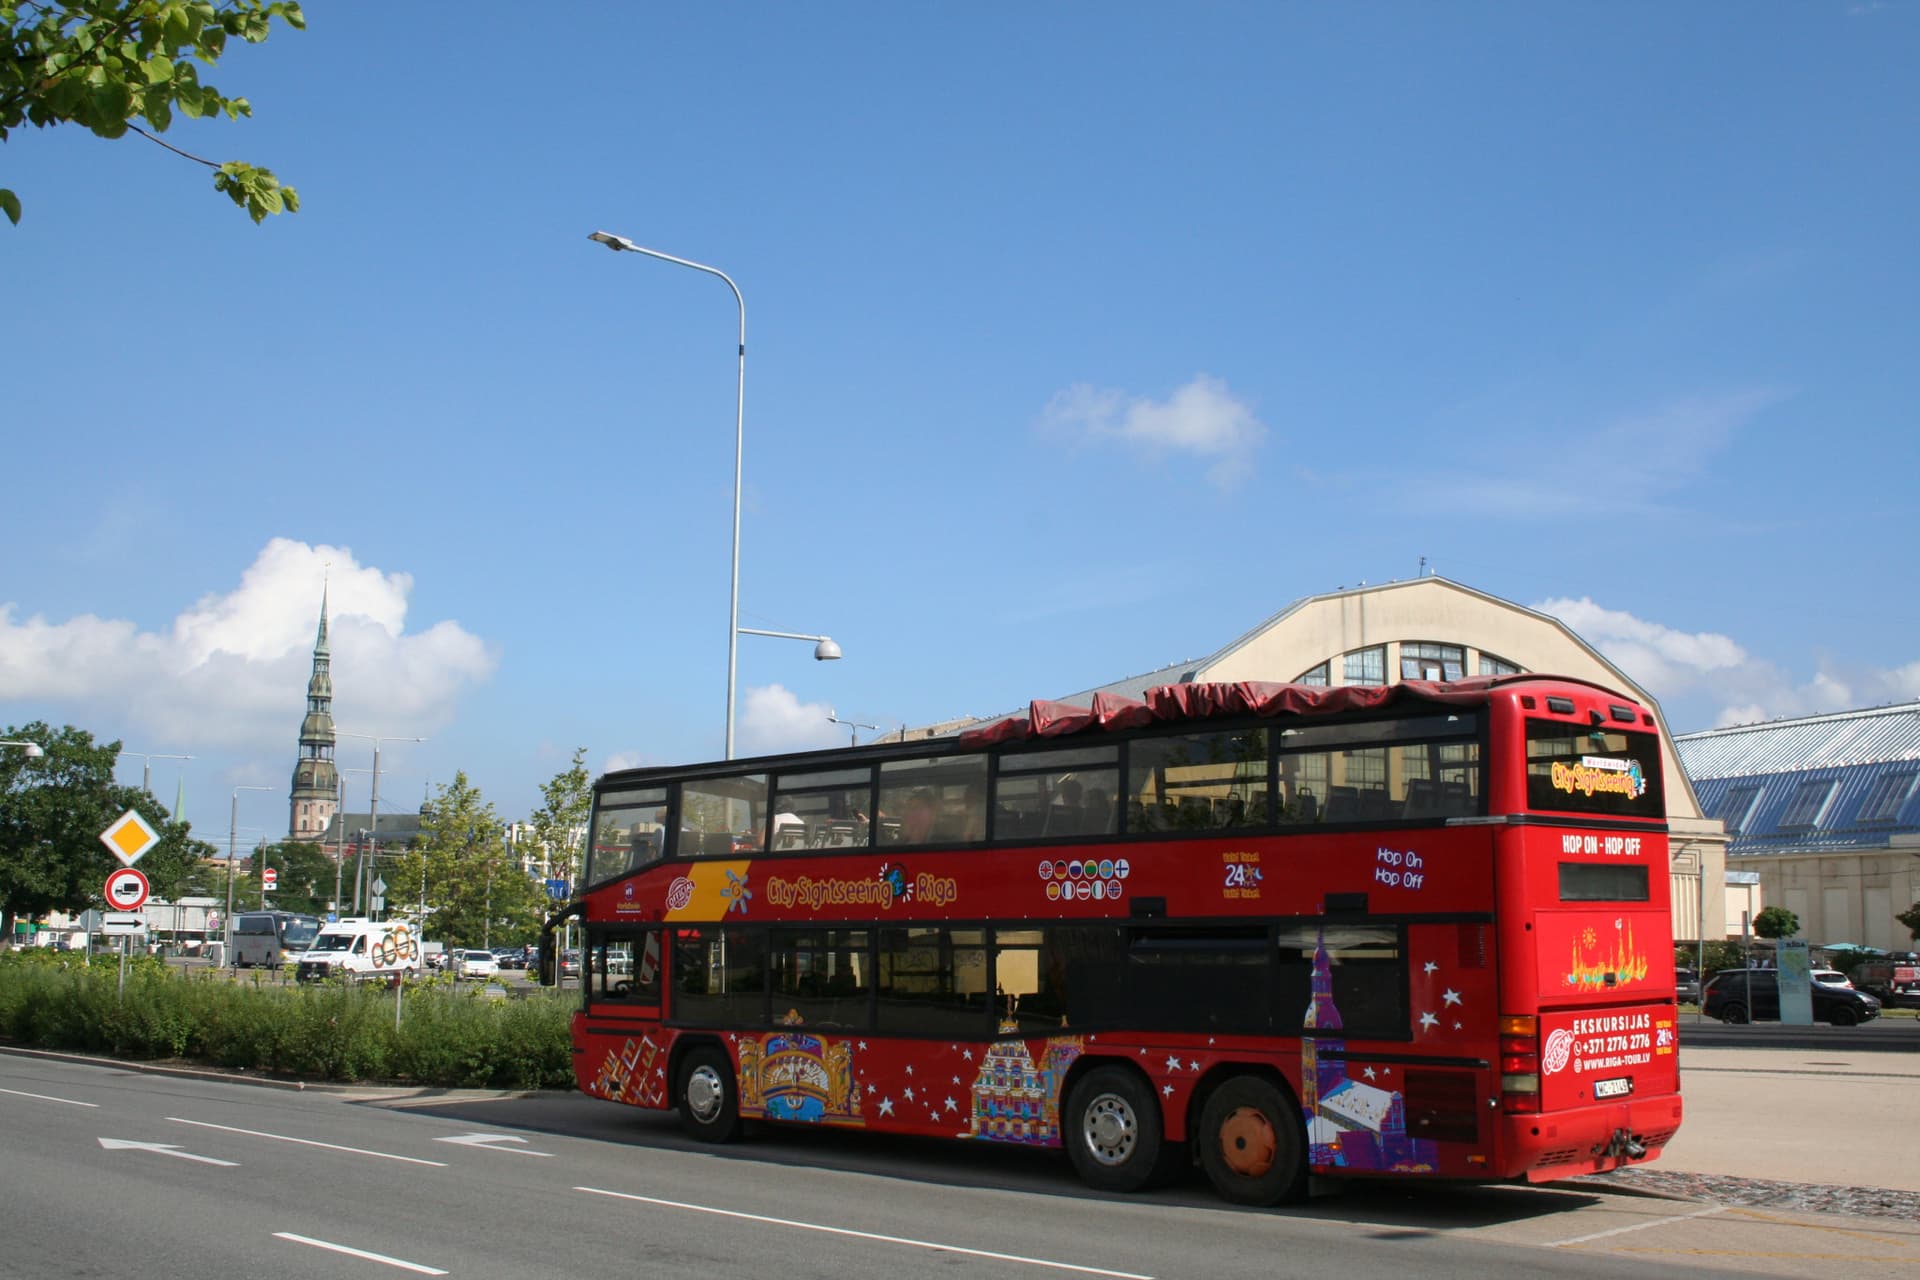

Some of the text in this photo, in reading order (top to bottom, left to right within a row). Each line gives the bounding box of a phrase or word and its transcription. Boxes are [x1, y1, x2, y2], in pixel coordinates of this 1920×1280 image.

[1562, 834, 1582, 853] HOP
[1584, 835, 1598, 854] ON
[1605, 836, 1624, 855] HOP
[1625, 837, 1641, 856] OFF
[1377, 847, 1423, 868] Hop On
[1225, 864, 1245, 887] 24
[1375, 866, 1424, 889] Hop Off
[916, 872, 957, 907] Riga
[1574, 1014, 1650, 1035] EKSKURSIJAS
[1583, 1034, 1650, 1054] +371 2776 2776
[1583, 1053, 1650, 1070] WWW.RIGA-TOUR.LV
